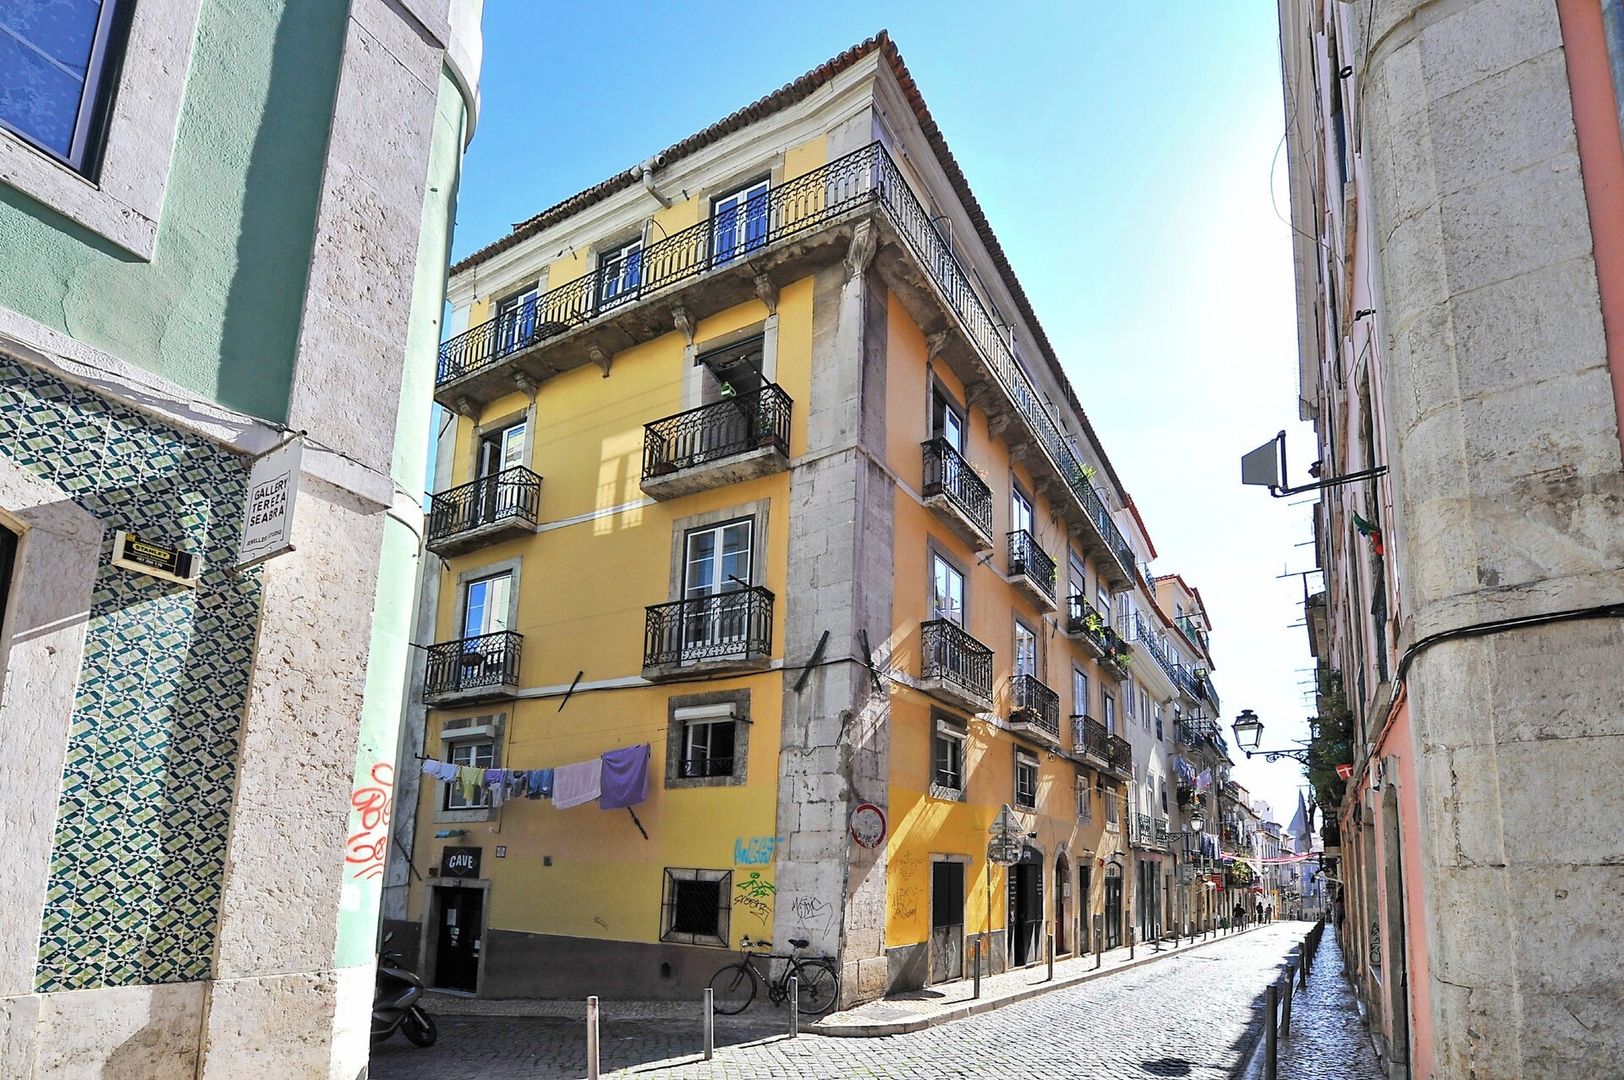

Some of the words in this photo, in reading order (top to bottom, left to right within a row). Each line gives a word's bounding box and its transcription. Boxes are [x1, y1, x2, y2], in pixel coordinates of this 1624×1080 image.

[254, 478, 288, 500] GALLERY
[252, 492, 286, 513] TEREZA
[250, 505, 284, 527] SEABRA
[135, 543, 168, 558] STANLEY
[449, 854, 473, 869] CAVE
